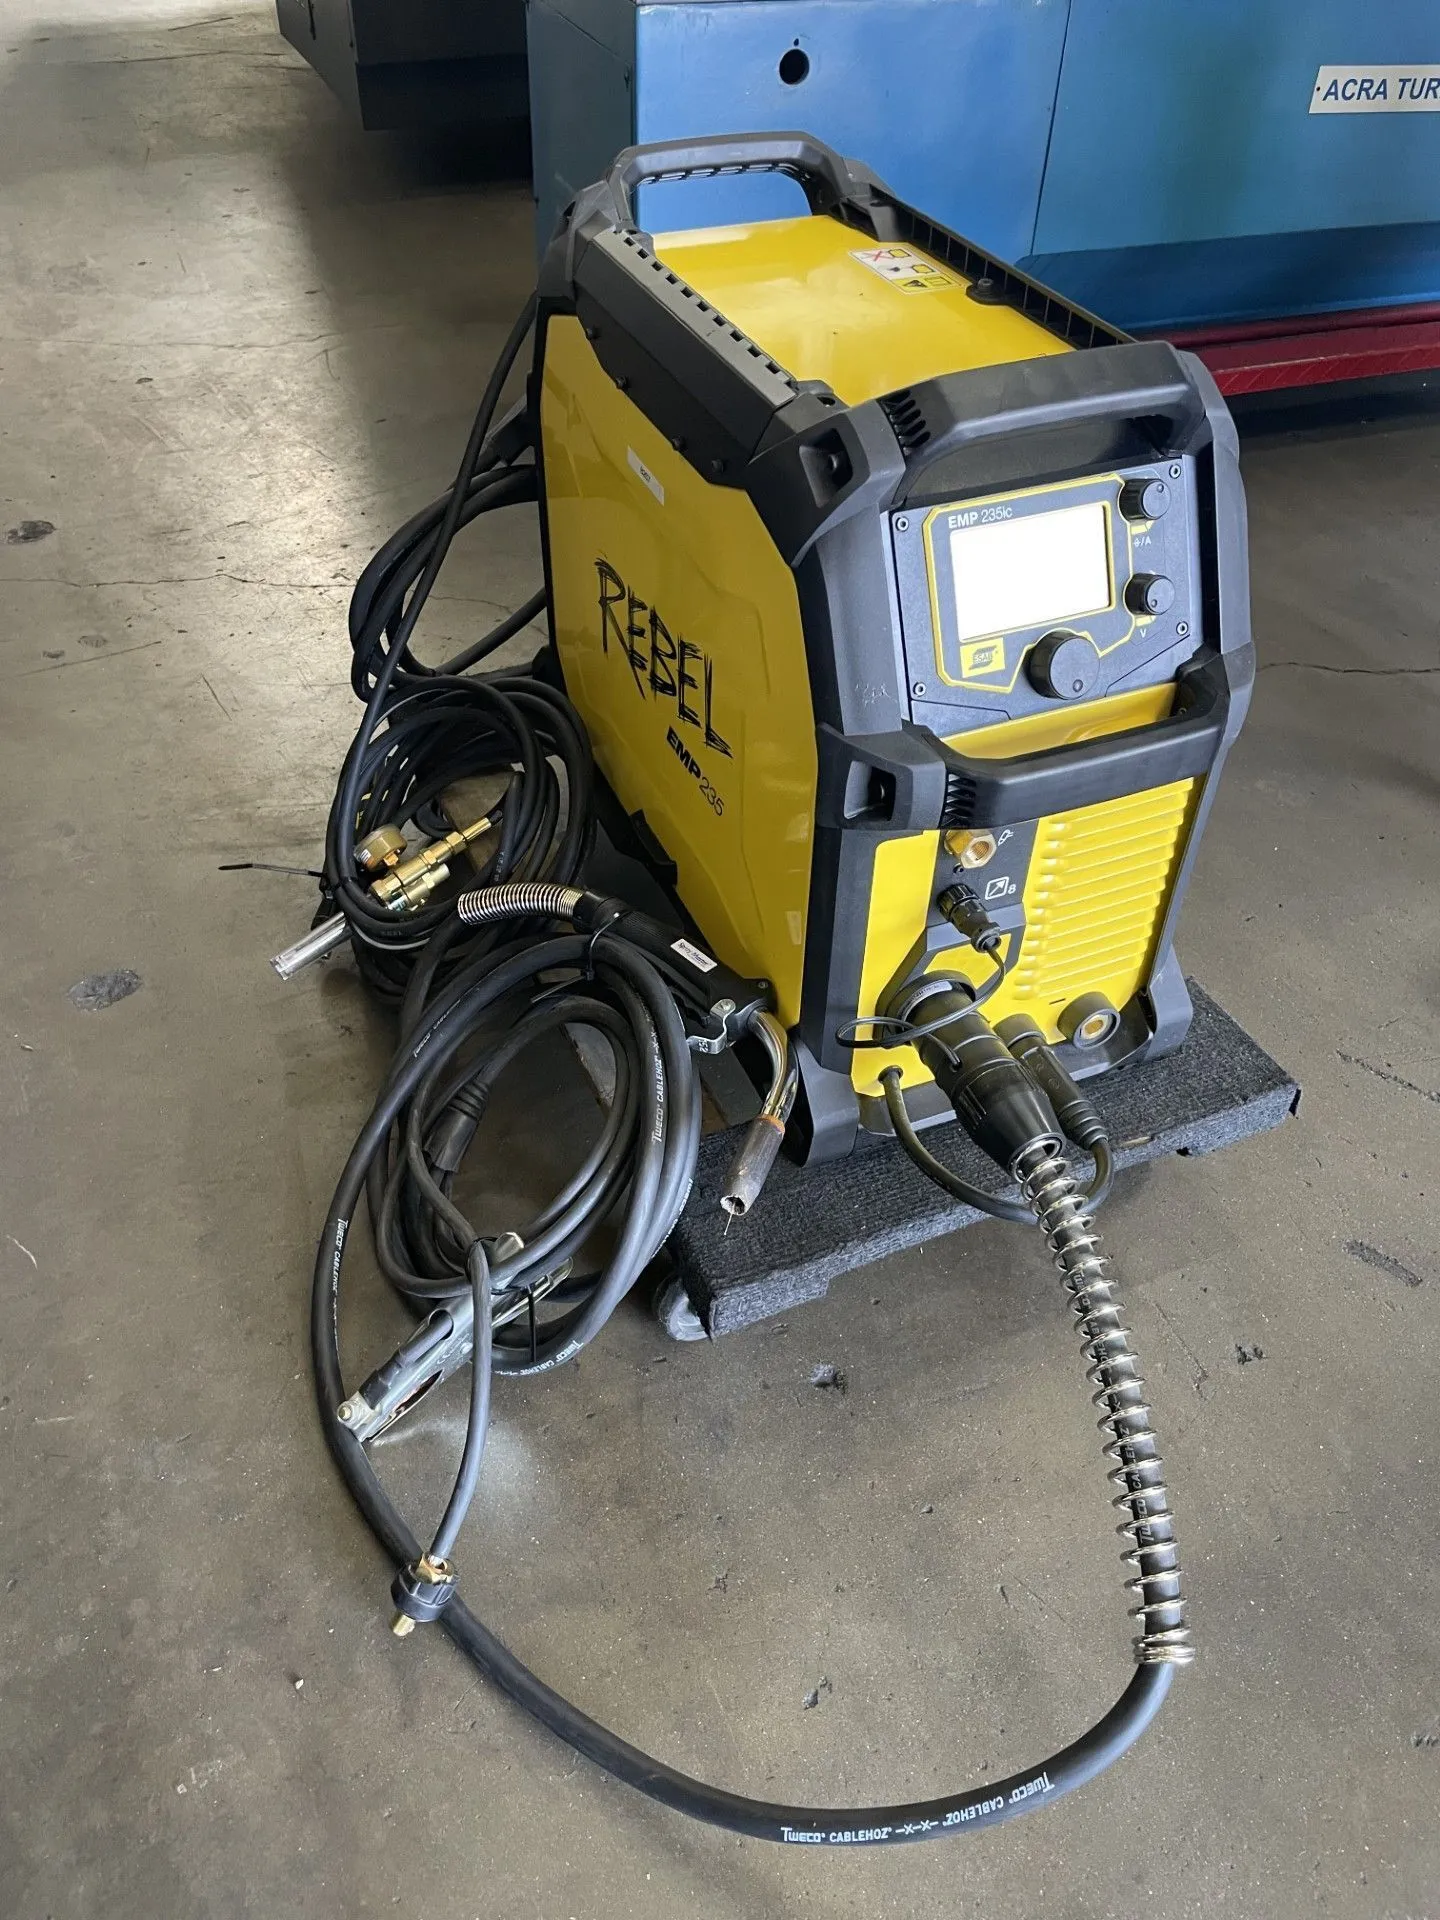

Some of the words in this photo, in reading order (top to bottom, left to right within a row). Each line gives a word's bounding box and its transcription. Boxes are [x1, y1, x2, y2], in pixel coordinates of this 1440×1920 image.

[1322, 78, 1387, 101] ACRA
[948, 511, 978, 529] EMP
[1140, 628, 1147, 638] V
[595, 553, 733, 760] REBEL
